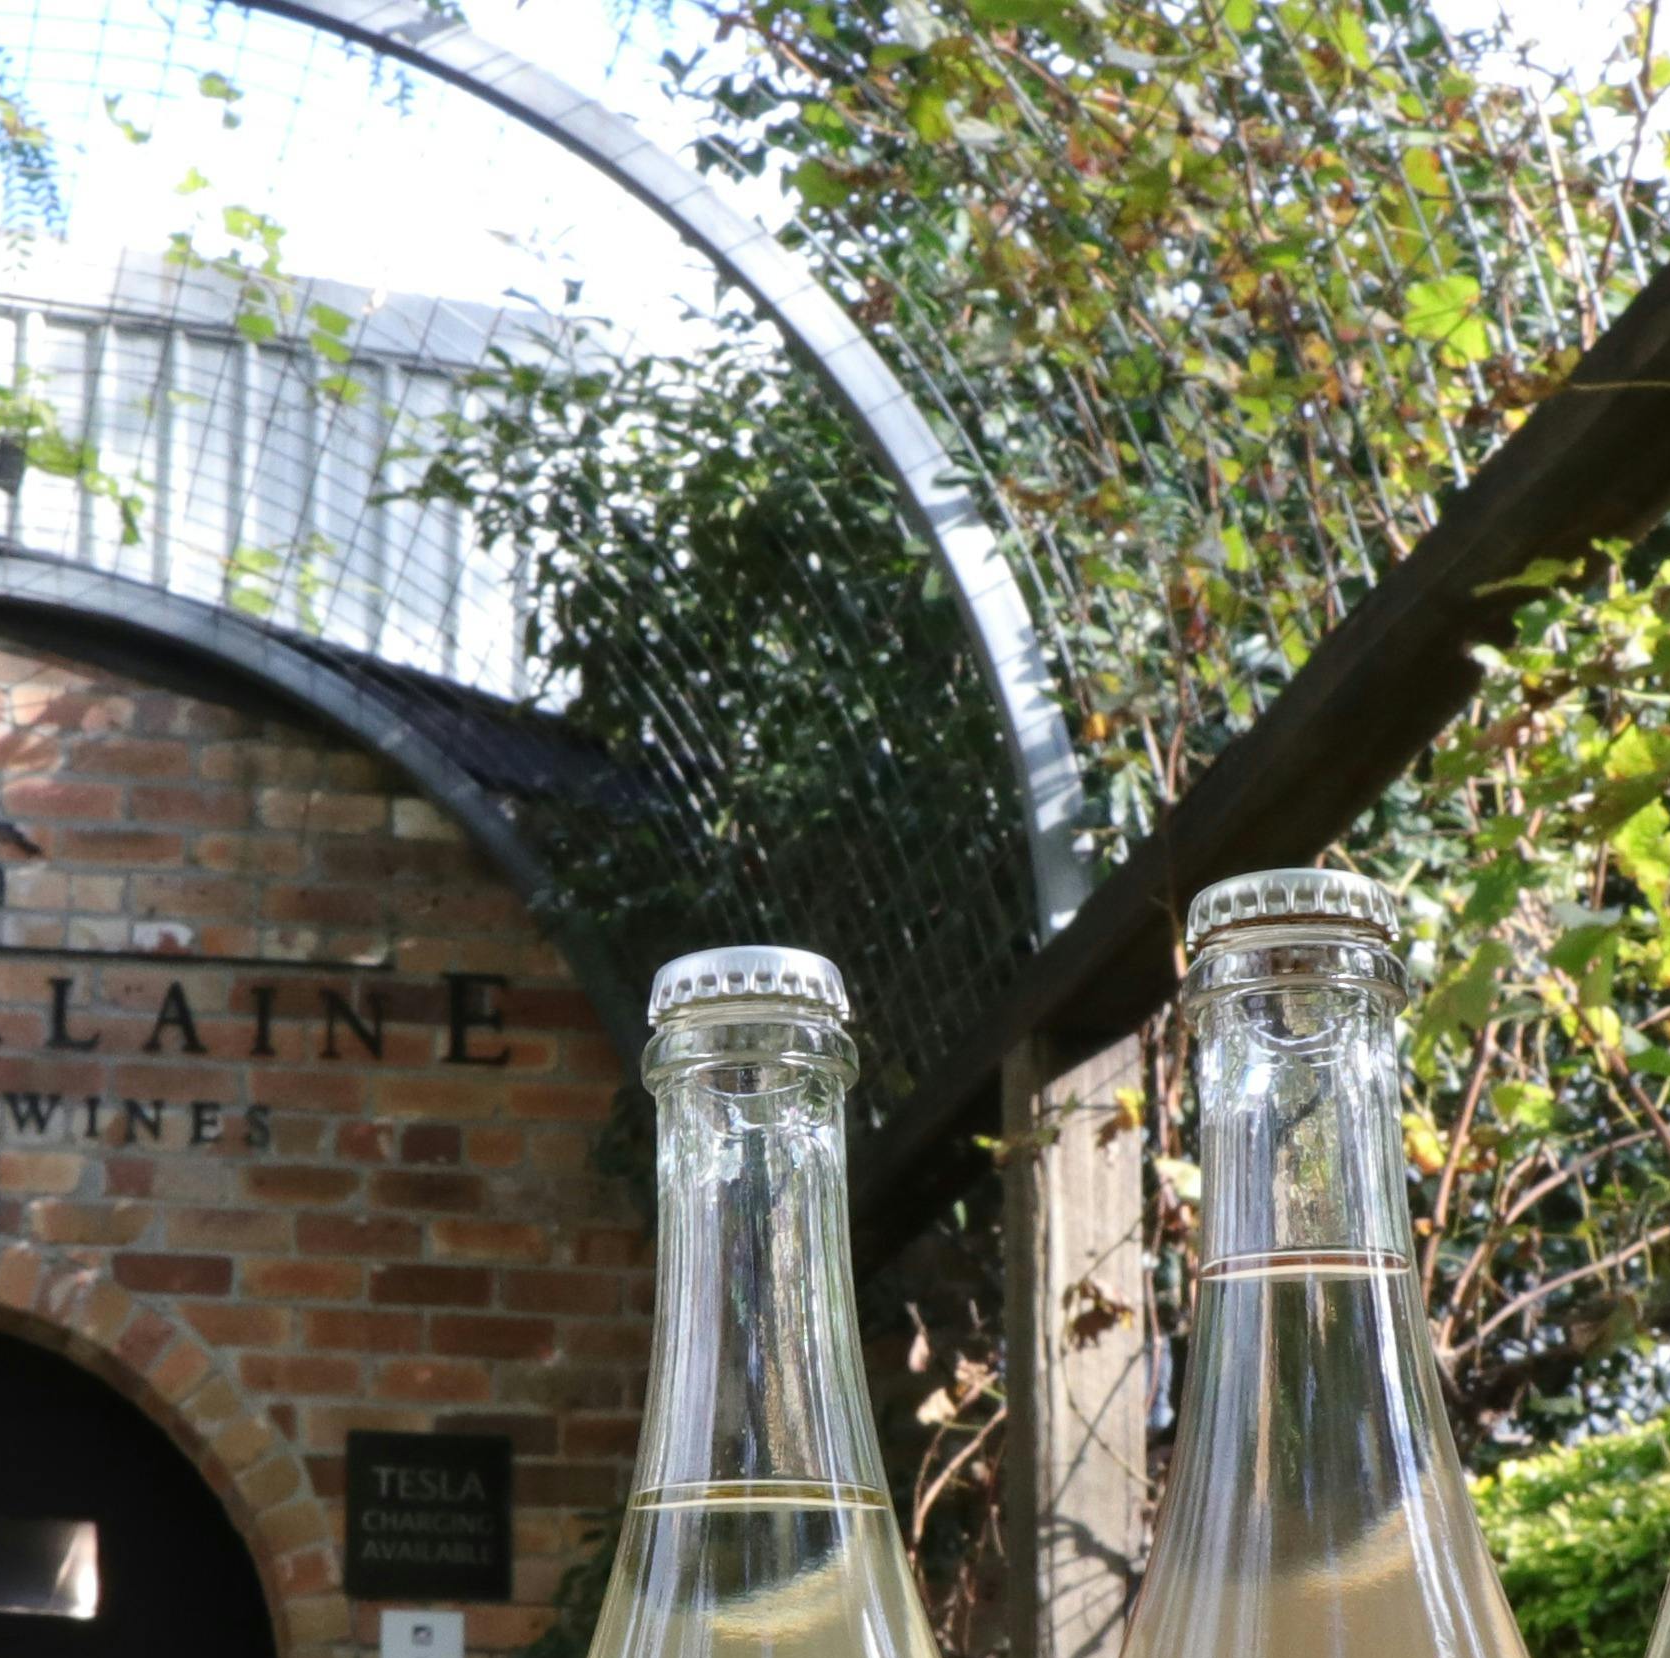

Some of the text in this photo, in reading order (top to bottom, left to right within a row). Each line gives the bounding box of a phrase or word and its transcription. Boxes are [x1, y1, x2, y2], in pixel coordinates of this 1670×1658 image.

[0, 1094, 271, 1148] WINES
[370, 1465, 486, 1502] TESLA
[361, 1508, 496, 1536] CHARGING
[360, 1538, 494, 1566] AVAILABLE
